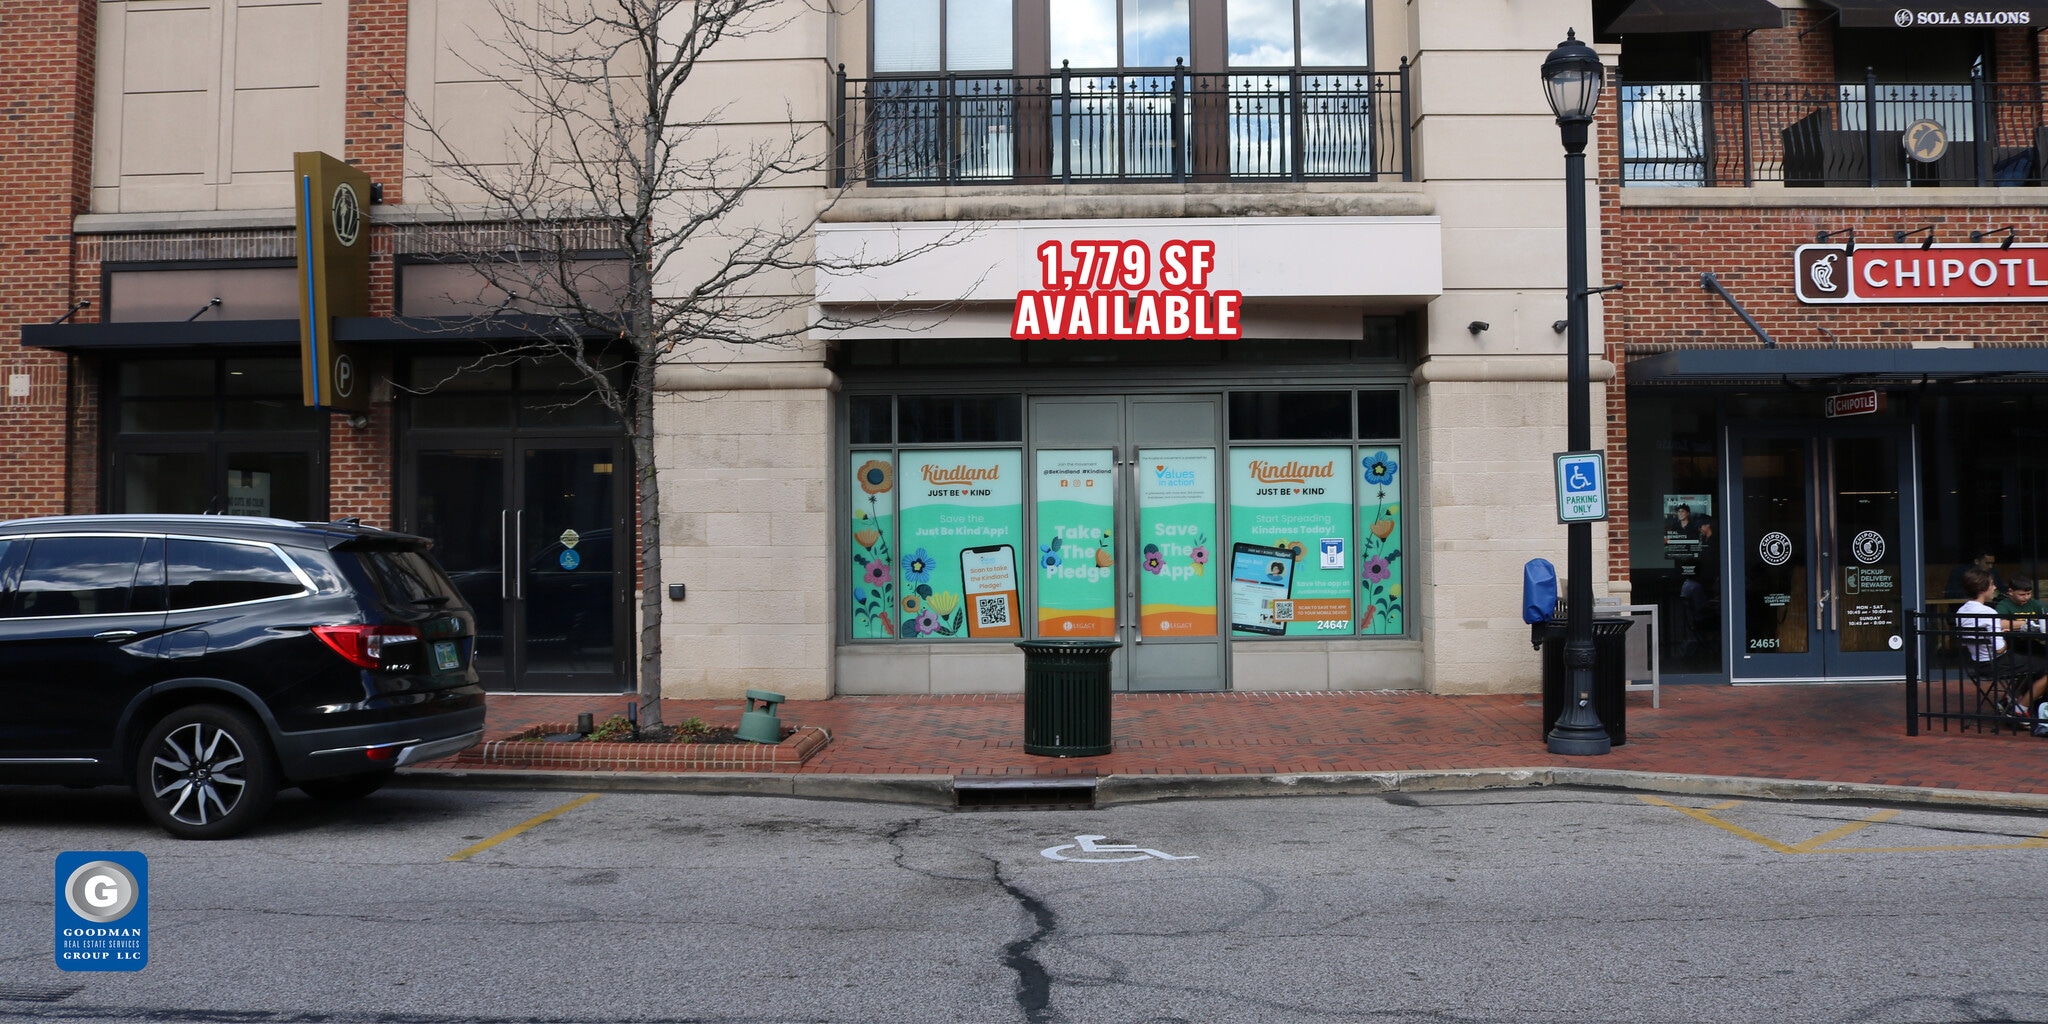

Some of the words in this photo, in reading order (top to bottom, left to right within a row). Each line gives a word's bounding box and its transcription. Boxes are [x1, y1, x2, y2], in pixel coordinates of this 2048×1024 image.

[1917, 11, 1961, 25] SOLA
[1964, 11, 2030, 25] SALONS
[1862, 257, 2048, 288] CHIPOTL
[339, 362, 350, 389] P
[1835, 395, 1875, 412] CHIPOTLE
[920, 464, 1000, 486] Kindland
[1248, 460, 1335, 484] Kindland
[927, 489, 948, 497] JUST
[950, 489, 959, 497] BE
[1256, 488, 1278, 496] JUST
[1566, 494, 1598, 505] PARKING
[1572, 504, 1592, 514] ONLY
[940, 514, 965, 523] Save
[967, 514, 985, 523] the
[1256, 514, 1279, 523] Start
[1281, 514, 1331, 525] Spreading
[915, 527, 939, 536] Just
[941, 527, 954, 536] Be
[1054, 524, 1101, 540] Take
[1155, 522, 1198, 536] Save
[1252, 525, 1299, 534] Kindness
[1300, 525, 1335, 536] Today!
[1762, 534, 1789, 547] CHIPOTLE
[1855, 532, 1882, 546] CHIPOTLE
[1061, 544, 1095, 559] The
[1160, 543, 1193, 557] The
[981, 573, 1009, 581] Kindland
[1046, 564, 1111, 583] Pledge
[1158, 563, 1195, 581] App
[1316, 620, 1349, 630] 24647
[1750, 638, 1780, 649] 24651
